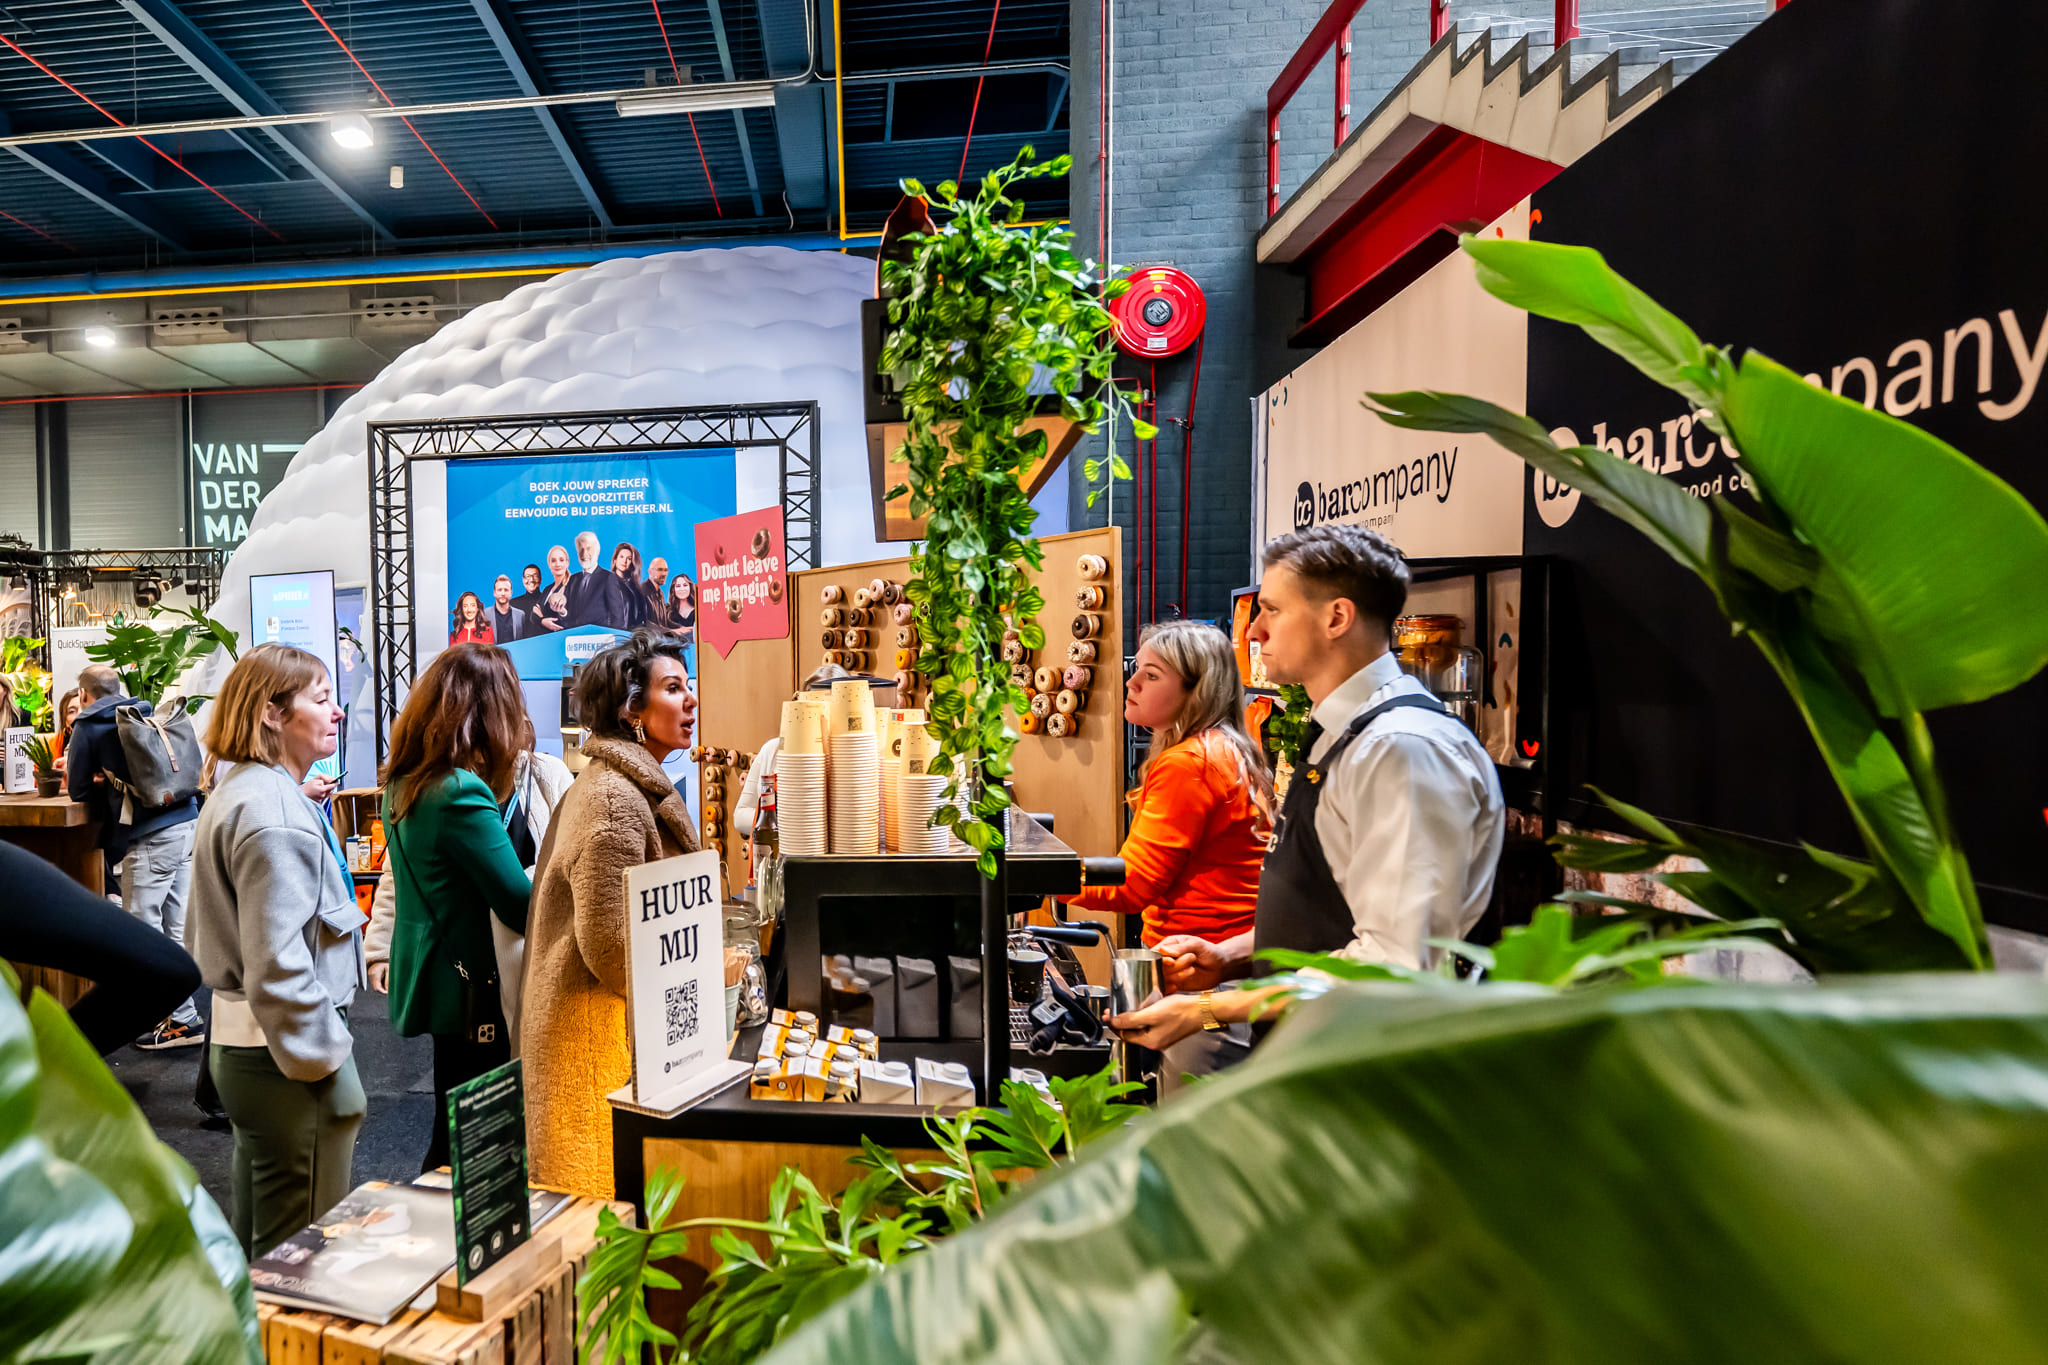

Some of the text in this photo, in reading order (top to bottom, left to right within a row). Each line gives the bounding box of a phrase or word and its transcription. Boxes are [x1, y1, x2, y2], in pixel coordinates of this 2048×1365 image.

[193, 443, 259, 475] VAN
[200, 480, 261, 510] DER
[529, 478, 649, 492] BOEK JOUW SPREKER
[534, 491, 644, 505] OF DAGVOORZITTER
[1318, 446, 1458, 523] barcompany
[1681, 474, 1723, 499] ood
[505, 503, 674, 518] EENVOUDIG BIJ DESPREKER.NL
[701, 555, 779, 582] Donut leave
[702, 587, 721, 604] me
[640, 874, 713, 922] HUUR
[659, 923, 699, 967] MIJ
